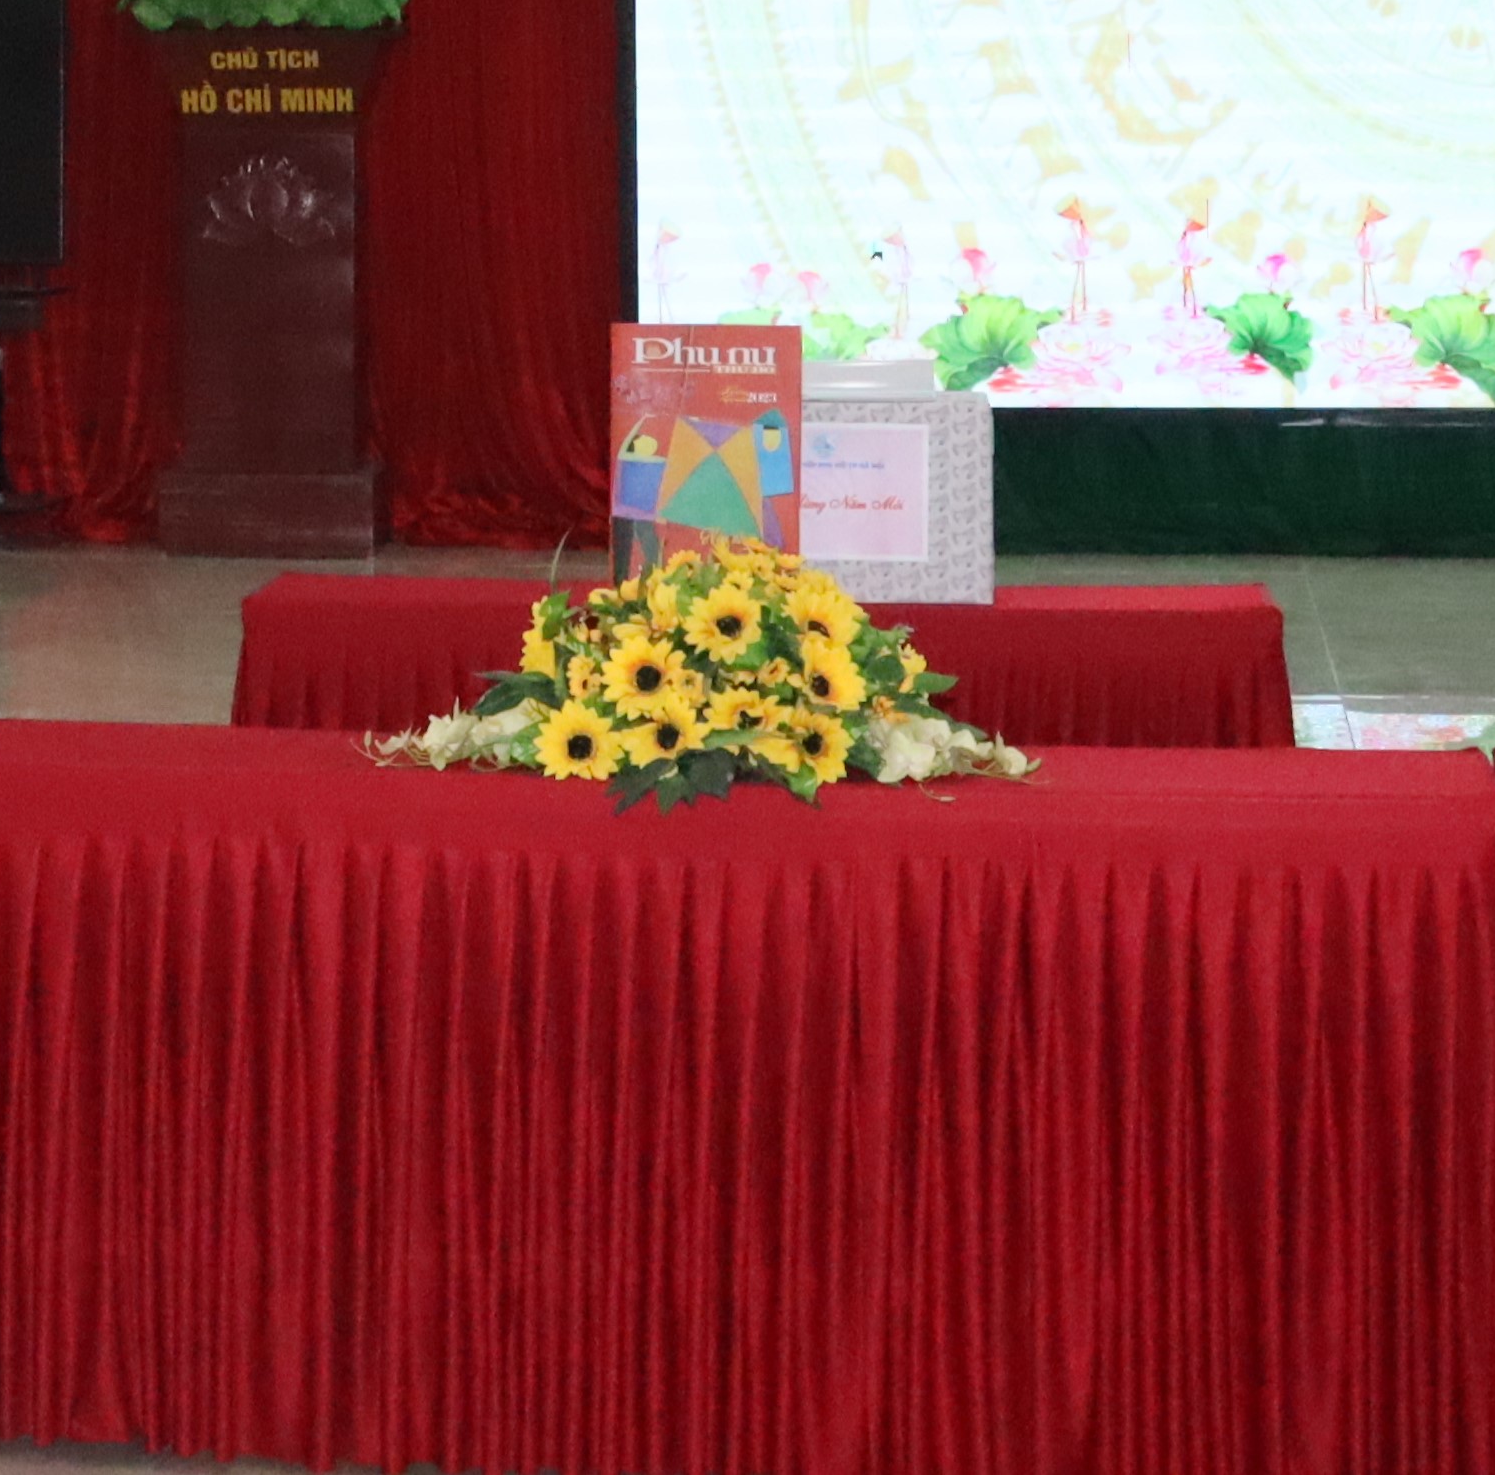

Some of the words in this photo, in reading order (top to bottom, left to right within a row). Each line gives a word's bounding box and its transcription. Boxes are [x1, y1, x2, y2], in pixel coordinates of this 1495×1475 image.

[210, 45, 259, 71] CHỦ
[266, 48, 320, 71] TỊCH
[180, 79, 219, 115] HỒ
[226, 83, 272, 114] CHÍ
[280, 87, 355, 114] MINH
